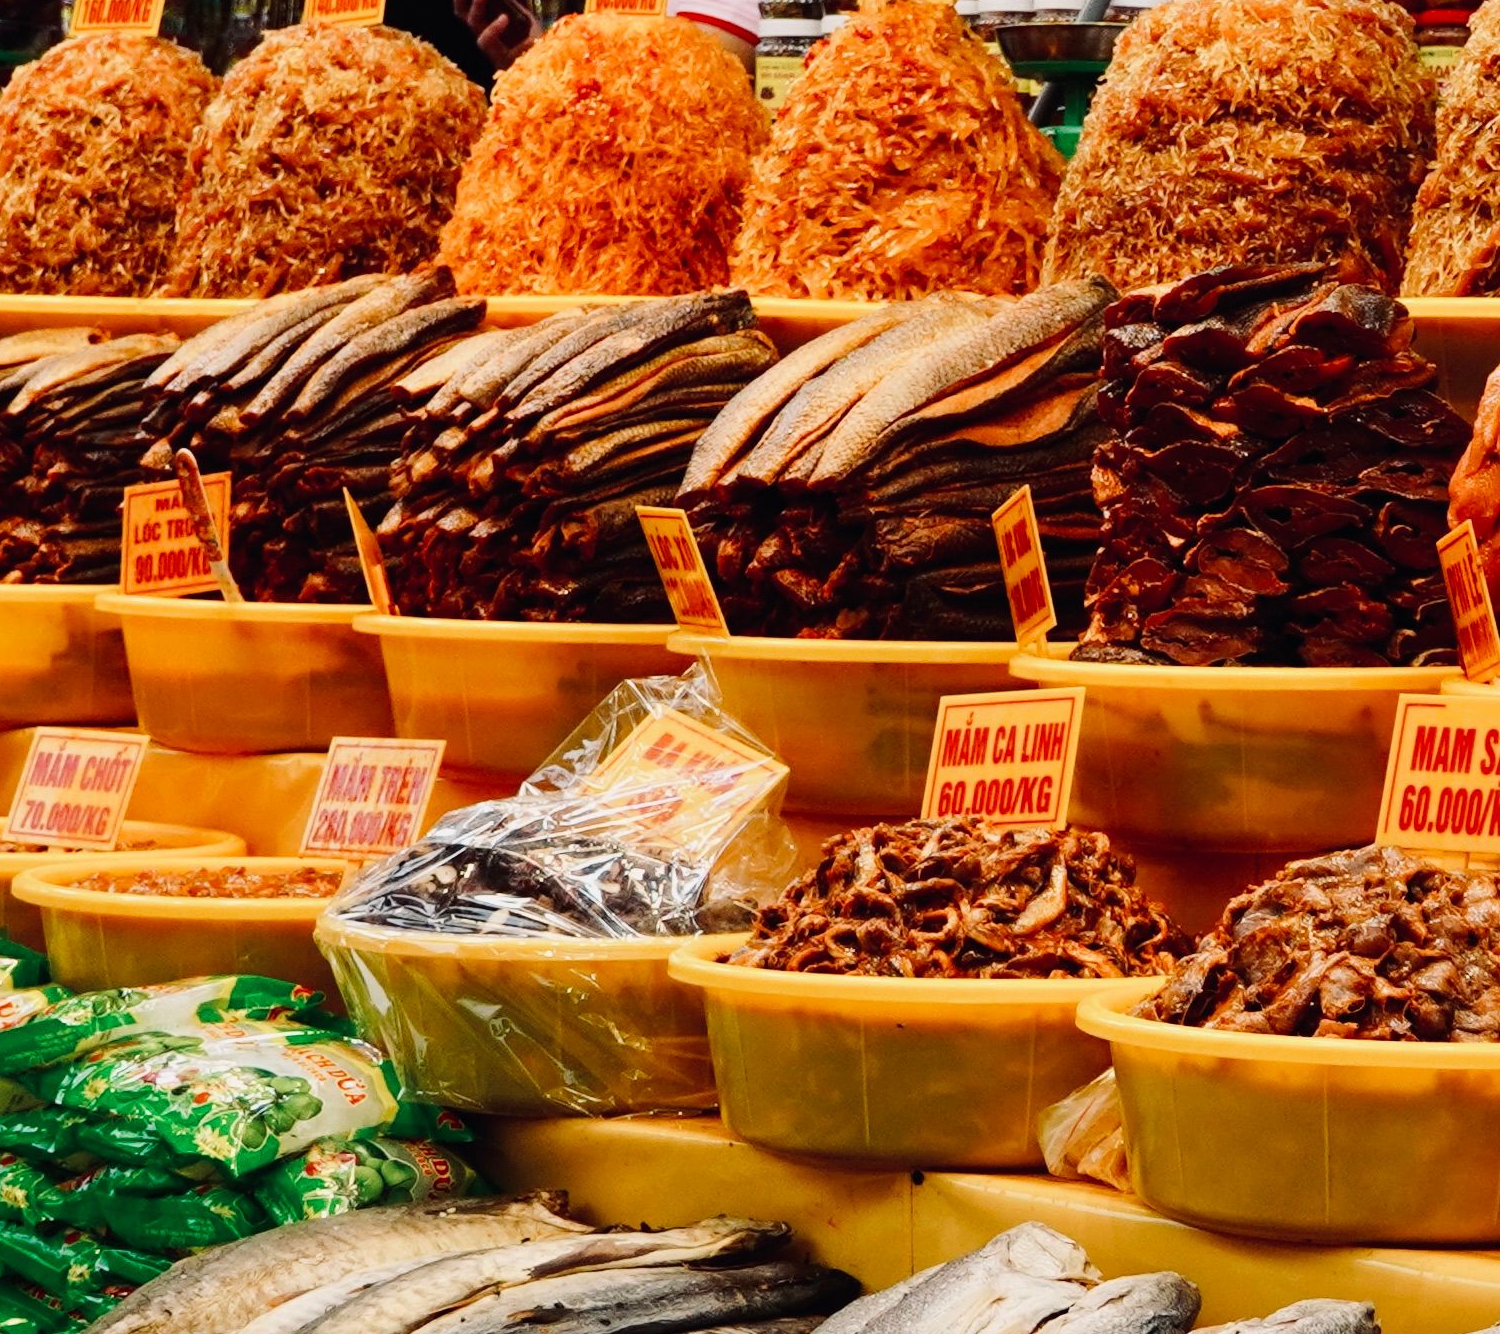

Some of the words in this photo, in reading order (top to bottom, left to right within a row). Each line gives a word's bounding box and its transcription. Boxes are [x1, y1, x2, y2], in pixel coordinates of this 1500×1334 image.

[1021, 709, 1067, 763] LINH
[28, 743, 78, 788] MẮM
[80, 747, 133, 793] CHỐT
[18, 798, 110, 837] 70.000/KG
[936, 774, 1054, 818] 60.000/KG
